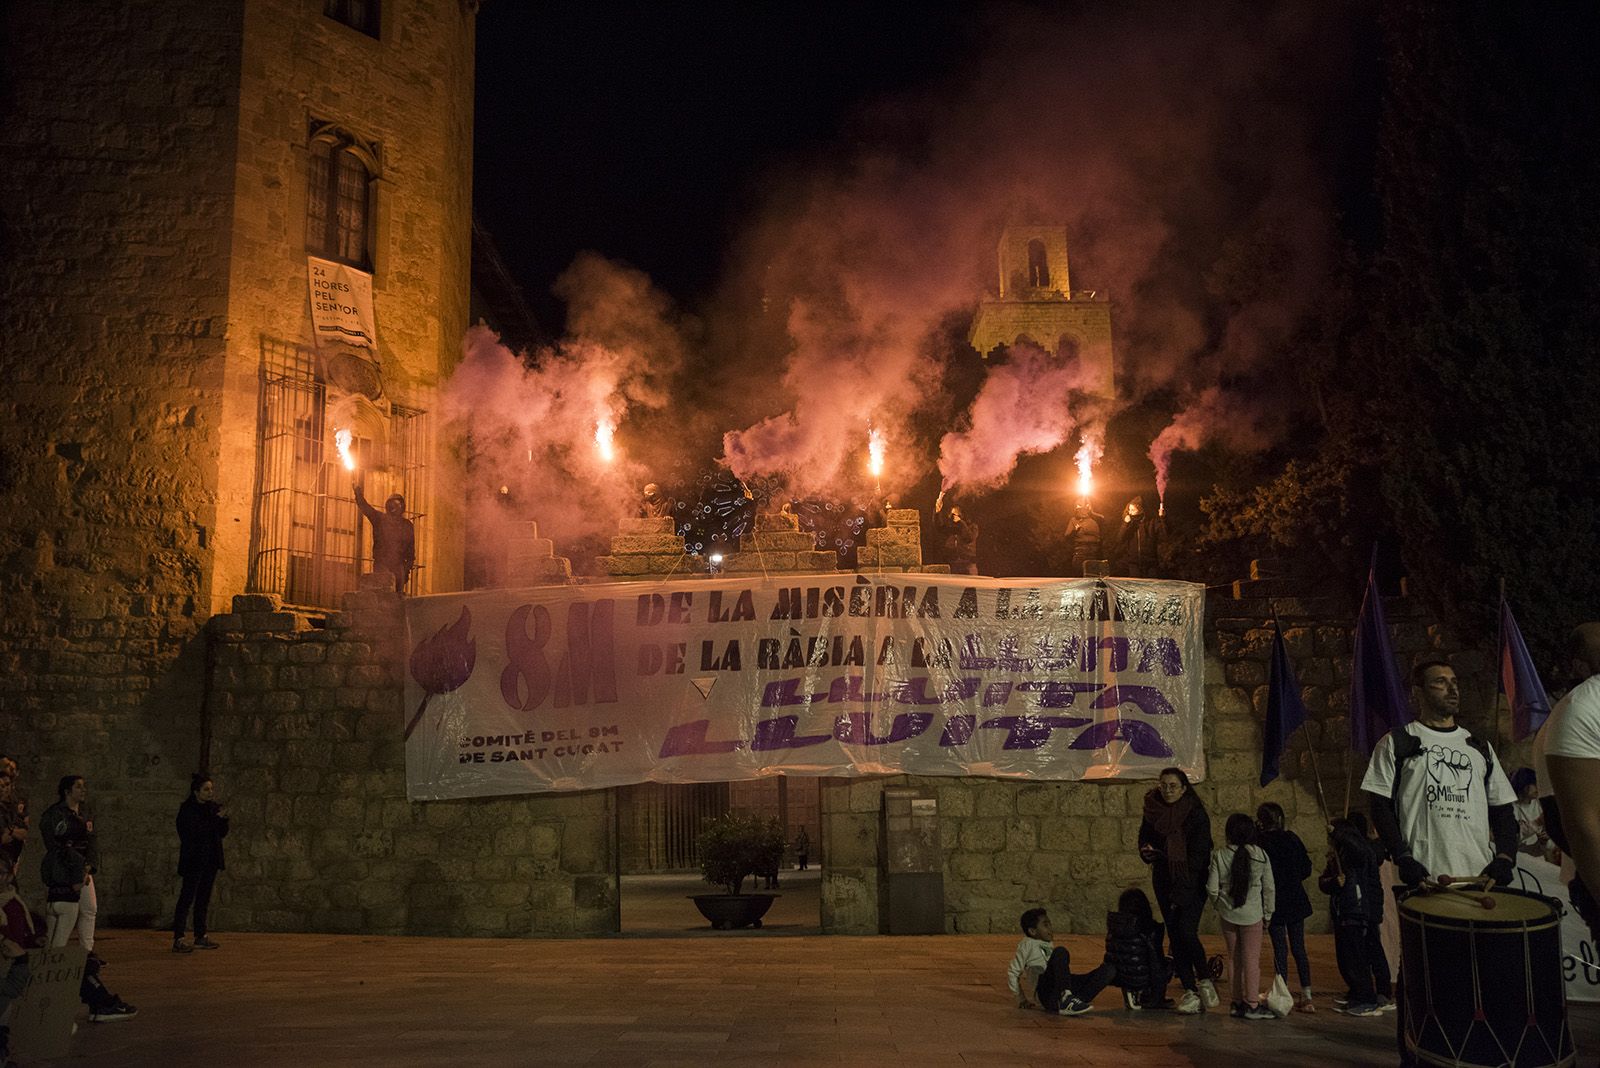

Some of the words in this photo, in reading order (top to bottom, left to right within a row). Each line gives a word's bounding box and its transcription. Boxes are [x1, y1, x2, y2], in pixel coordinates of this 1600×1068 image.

[313, 266, 326, 277] 24
[314, 279, 350, 293] HORES
[315, 290, 336, 301] PEL
[316, 302, 359, 316] SENYOR
[636, 591, 693, 626] DE
[707, 588, 756, 623] LA
[770, 575, 941, 622] MISÈRIA
[953, 586, 979, 619] A
[996, 587, 1044, 621] LA
[500, 598, 618, 711] 8M
[637, 642, 687, 676] DE
[700, 639, 742, 671] LA
[756, 627, 865, 672] RÀBIA
[877, 636, 895, 666] A
[761, 675, 1176, 714] LLUITA
[541, 728, 582, 743] DEL
[588, 725, 619, 738] 8M
[658, 712, 1175, 760] LLUITA
[459, 752, 486, 764] DE
[490, 748, 548, 763] SANT
[553, 741, 624, 758] CUGAT
